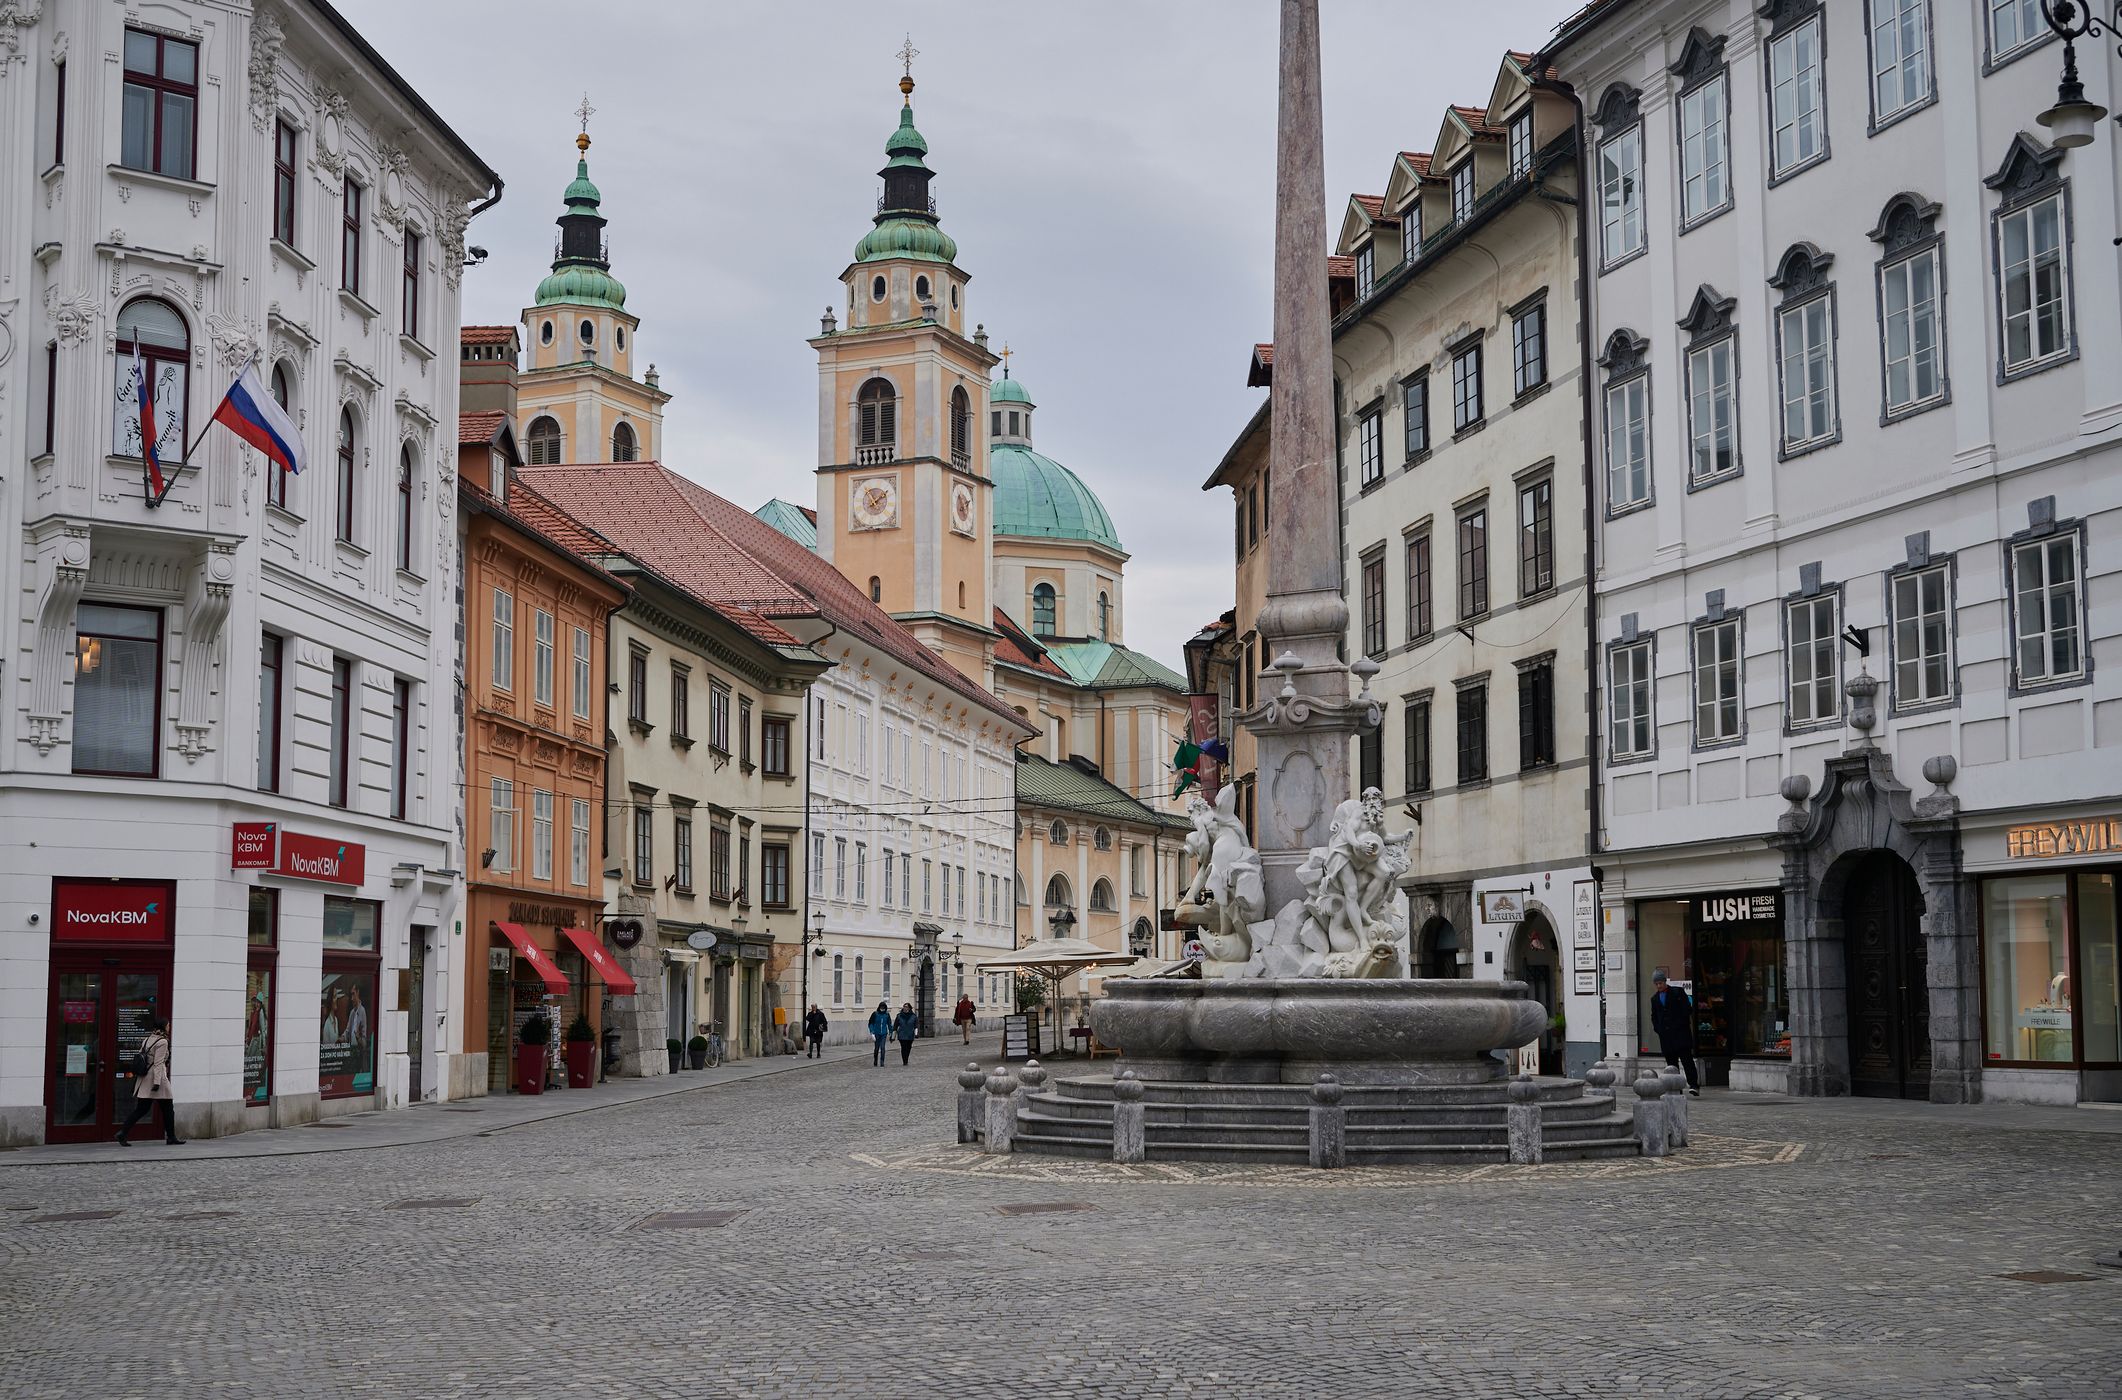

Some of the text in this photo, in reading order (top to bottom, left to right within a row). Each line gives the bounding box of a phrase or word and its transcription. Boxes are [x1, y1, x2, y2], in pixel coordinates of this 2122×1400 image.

[237, 832, 267, 841] Nova
[237, 843, 263, 852] KBM
[291, 852, 339, 877] NovaKBM
[1702, 895, 1775, 922] LUSH FRESH
[67, 910, 147, 924] NovaKBM
[1488, 912, 1523, 921] LAURA
